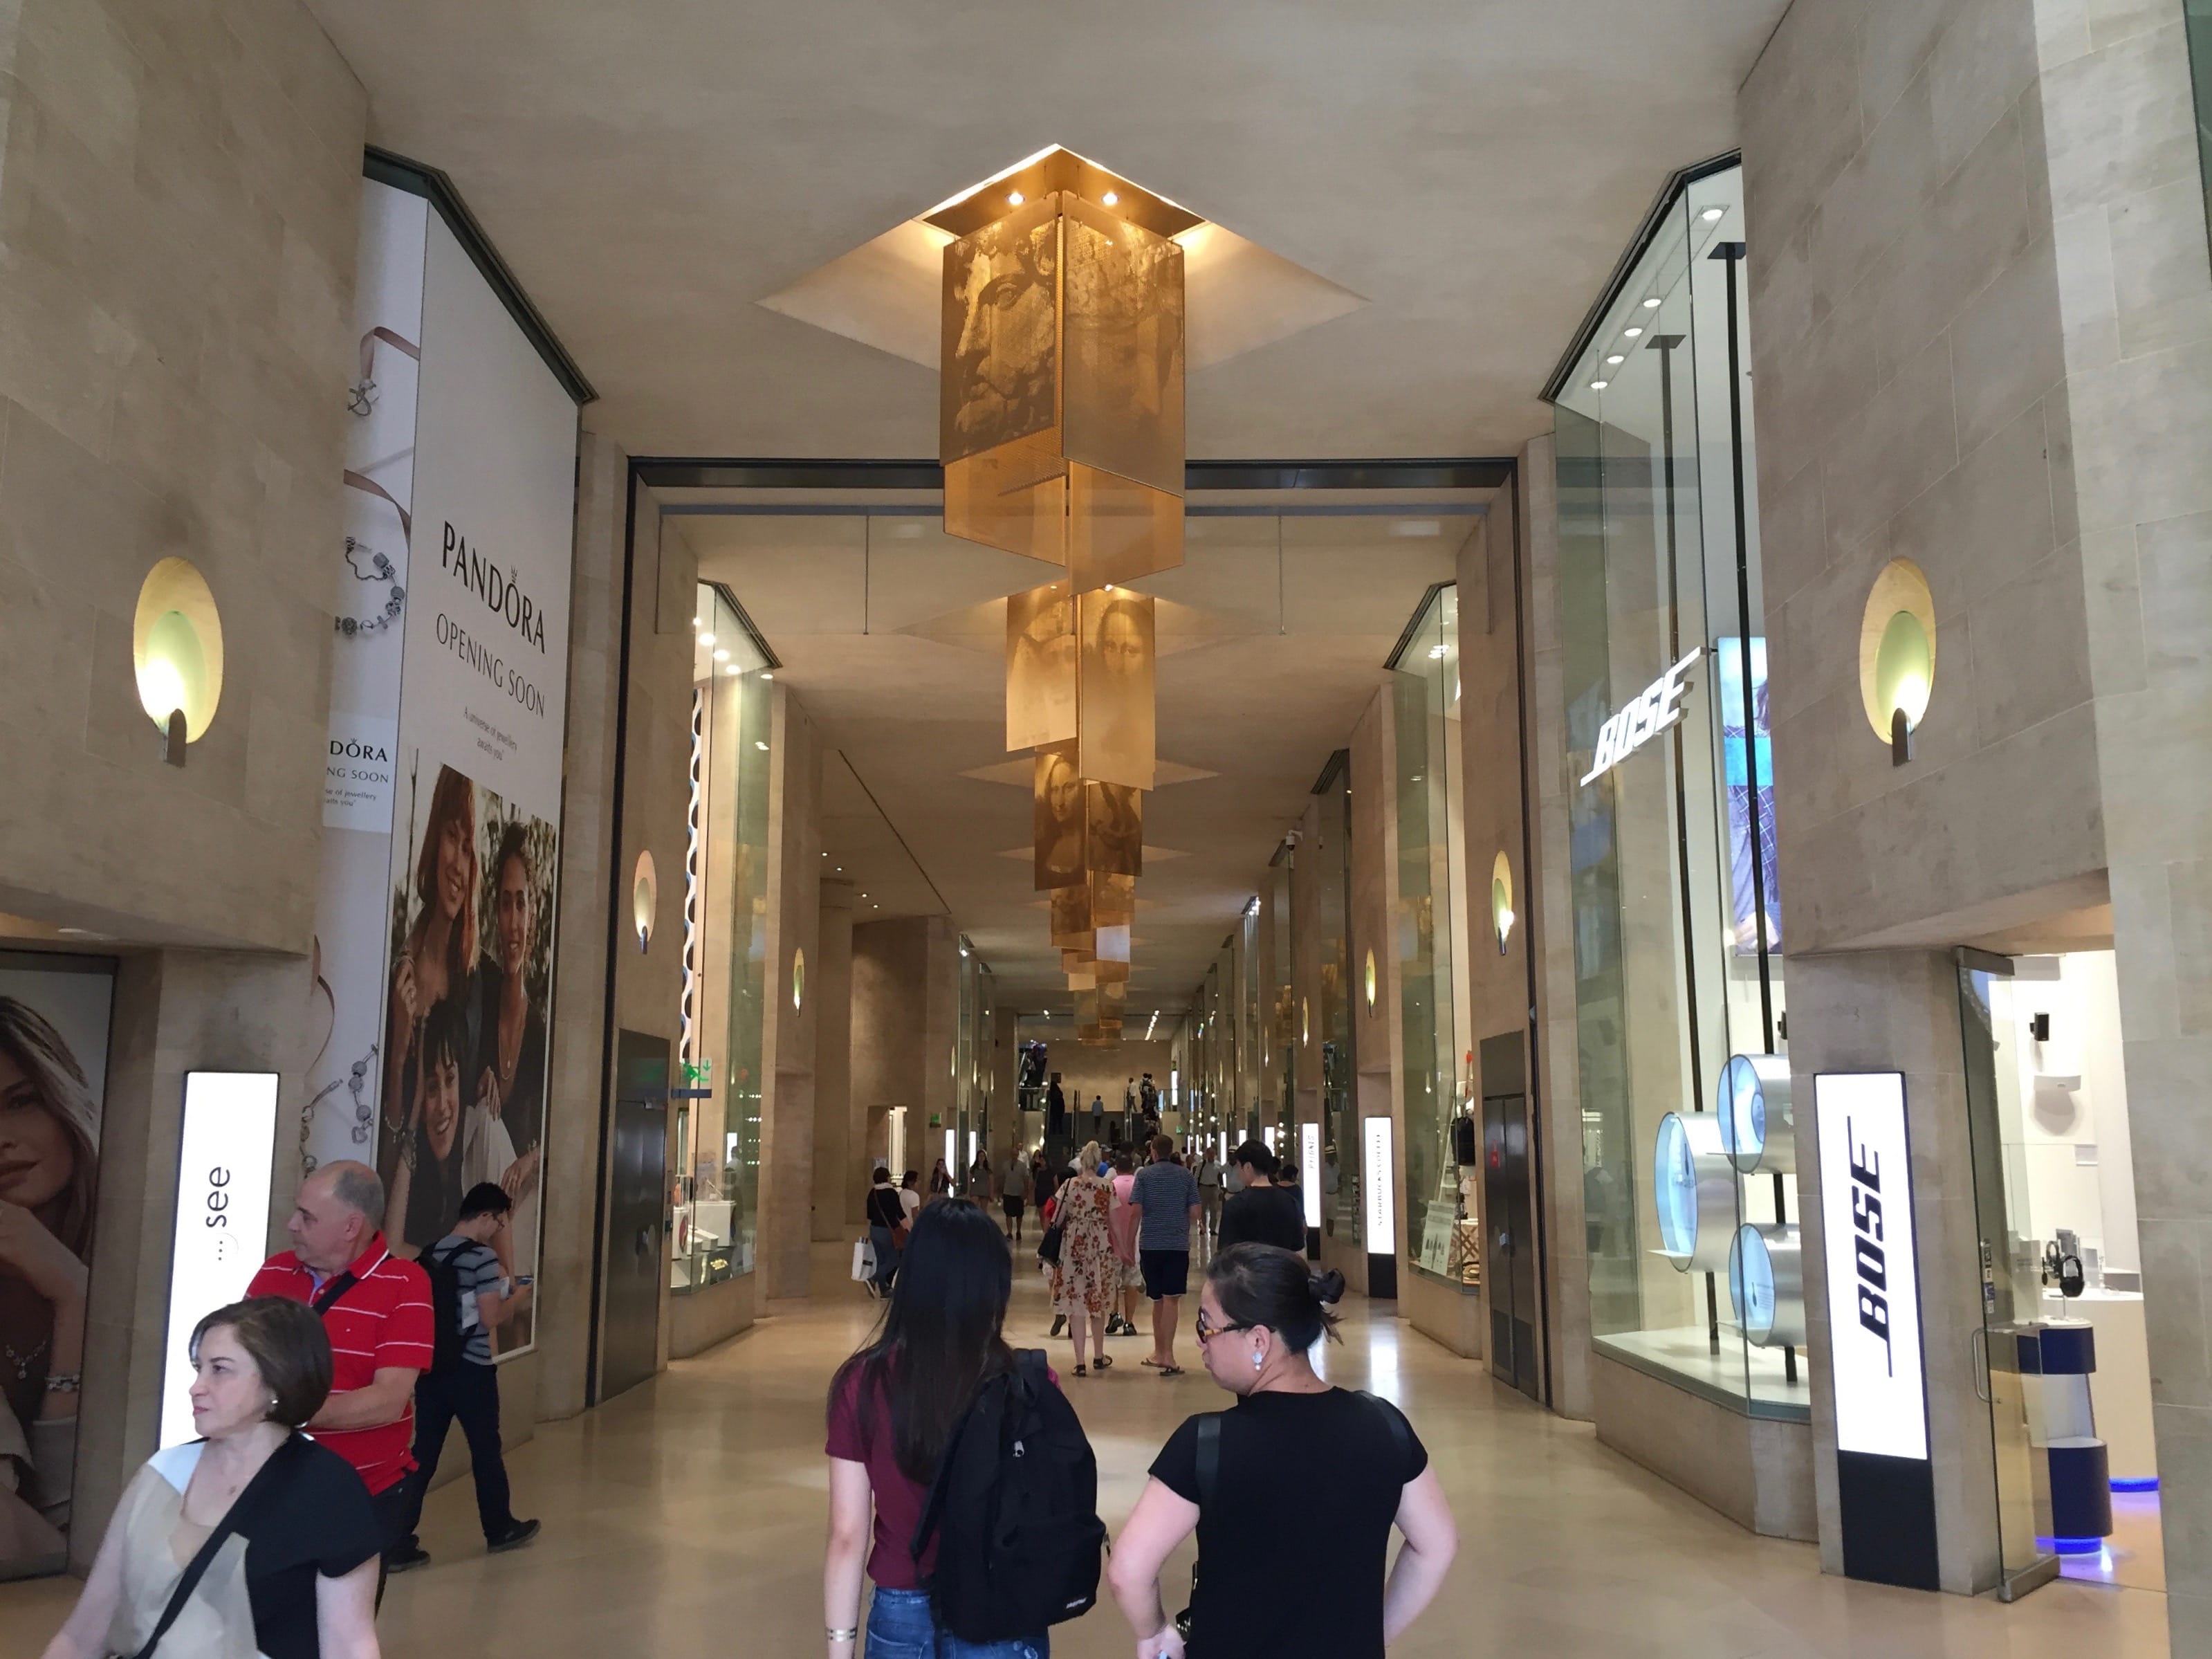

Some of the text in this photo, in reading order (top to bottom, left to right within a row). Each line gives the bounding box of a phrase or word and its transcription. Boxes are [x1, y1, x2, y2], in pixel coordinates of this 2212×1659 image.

[436, 613, 545, 719] OPENING SOON
[1580, 645, 1702, 787] BOSE
[344, 791, 376, 800] jewellery
[351, 769, 389, 783] SOON
[205, 1166, 231, 1228] see
[1847, 1115, 1893, 1378] BOSE
